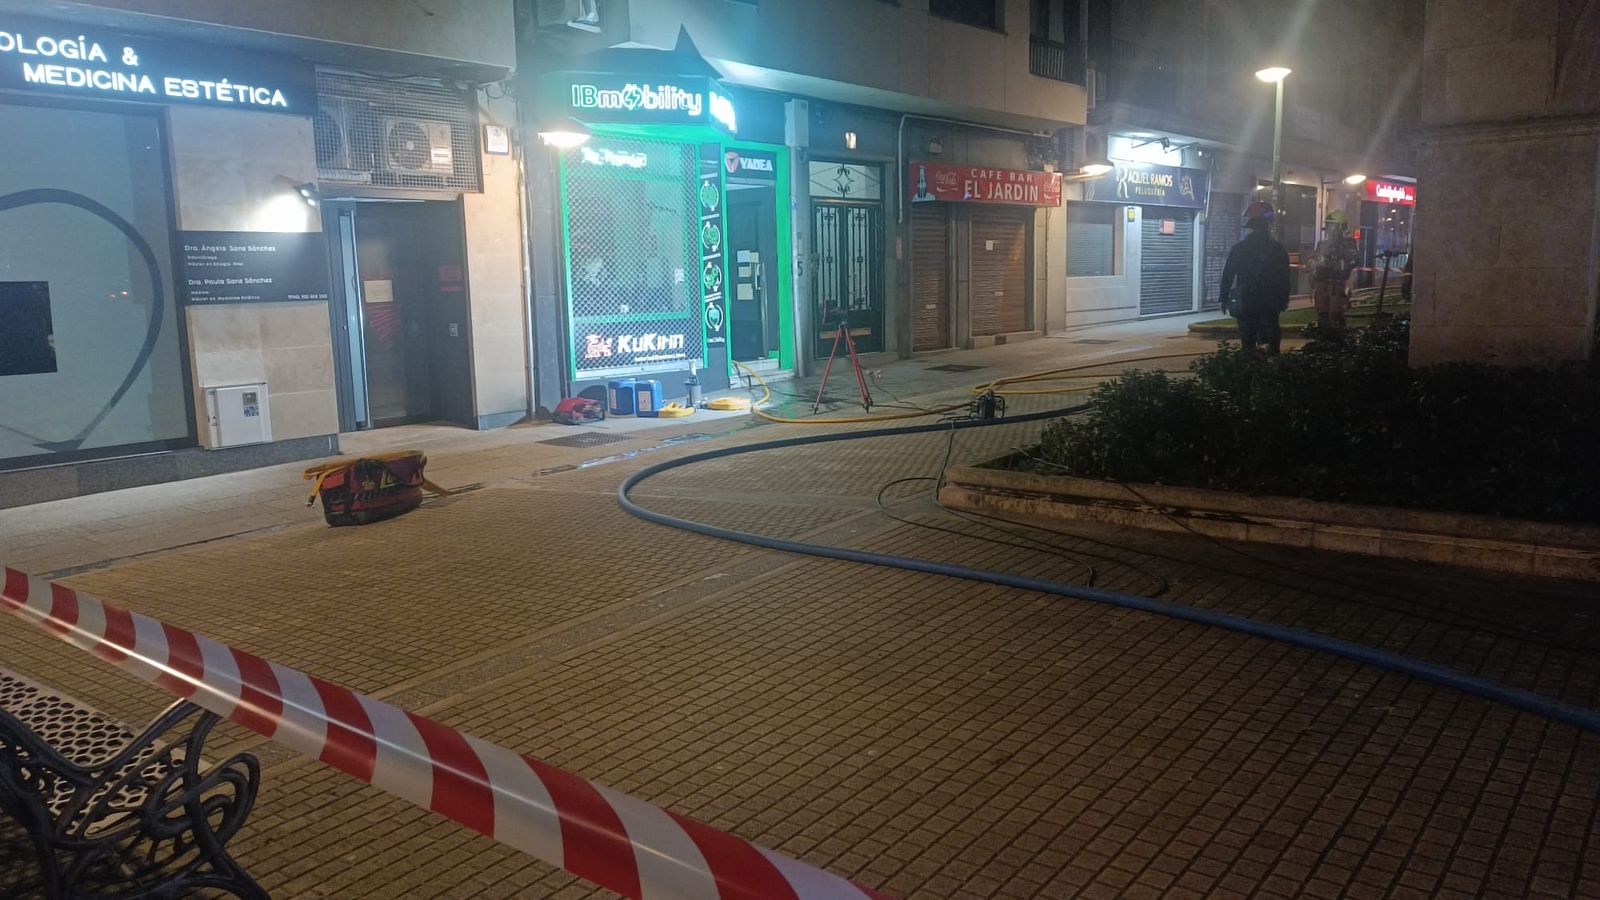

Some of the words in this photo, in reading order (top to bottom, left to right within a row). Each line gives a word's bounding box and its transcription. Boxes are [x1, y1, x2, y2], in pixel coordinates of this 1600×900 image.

[121, 47, 138, 66] &
[23, 63, 156, 94] MEDICINA
[164, 78, 287, 107] ESTÉTICA
[740, 157, 773, 171] YADEA
[970, 168, 1002, 180] CAFE
[1009, 172, 1033, 182] BAR
[1150, 173, 1173, 187] RAMOS
[964, 180, 981, 199] EL
[987, 182, 1039, 202] JARDIN
